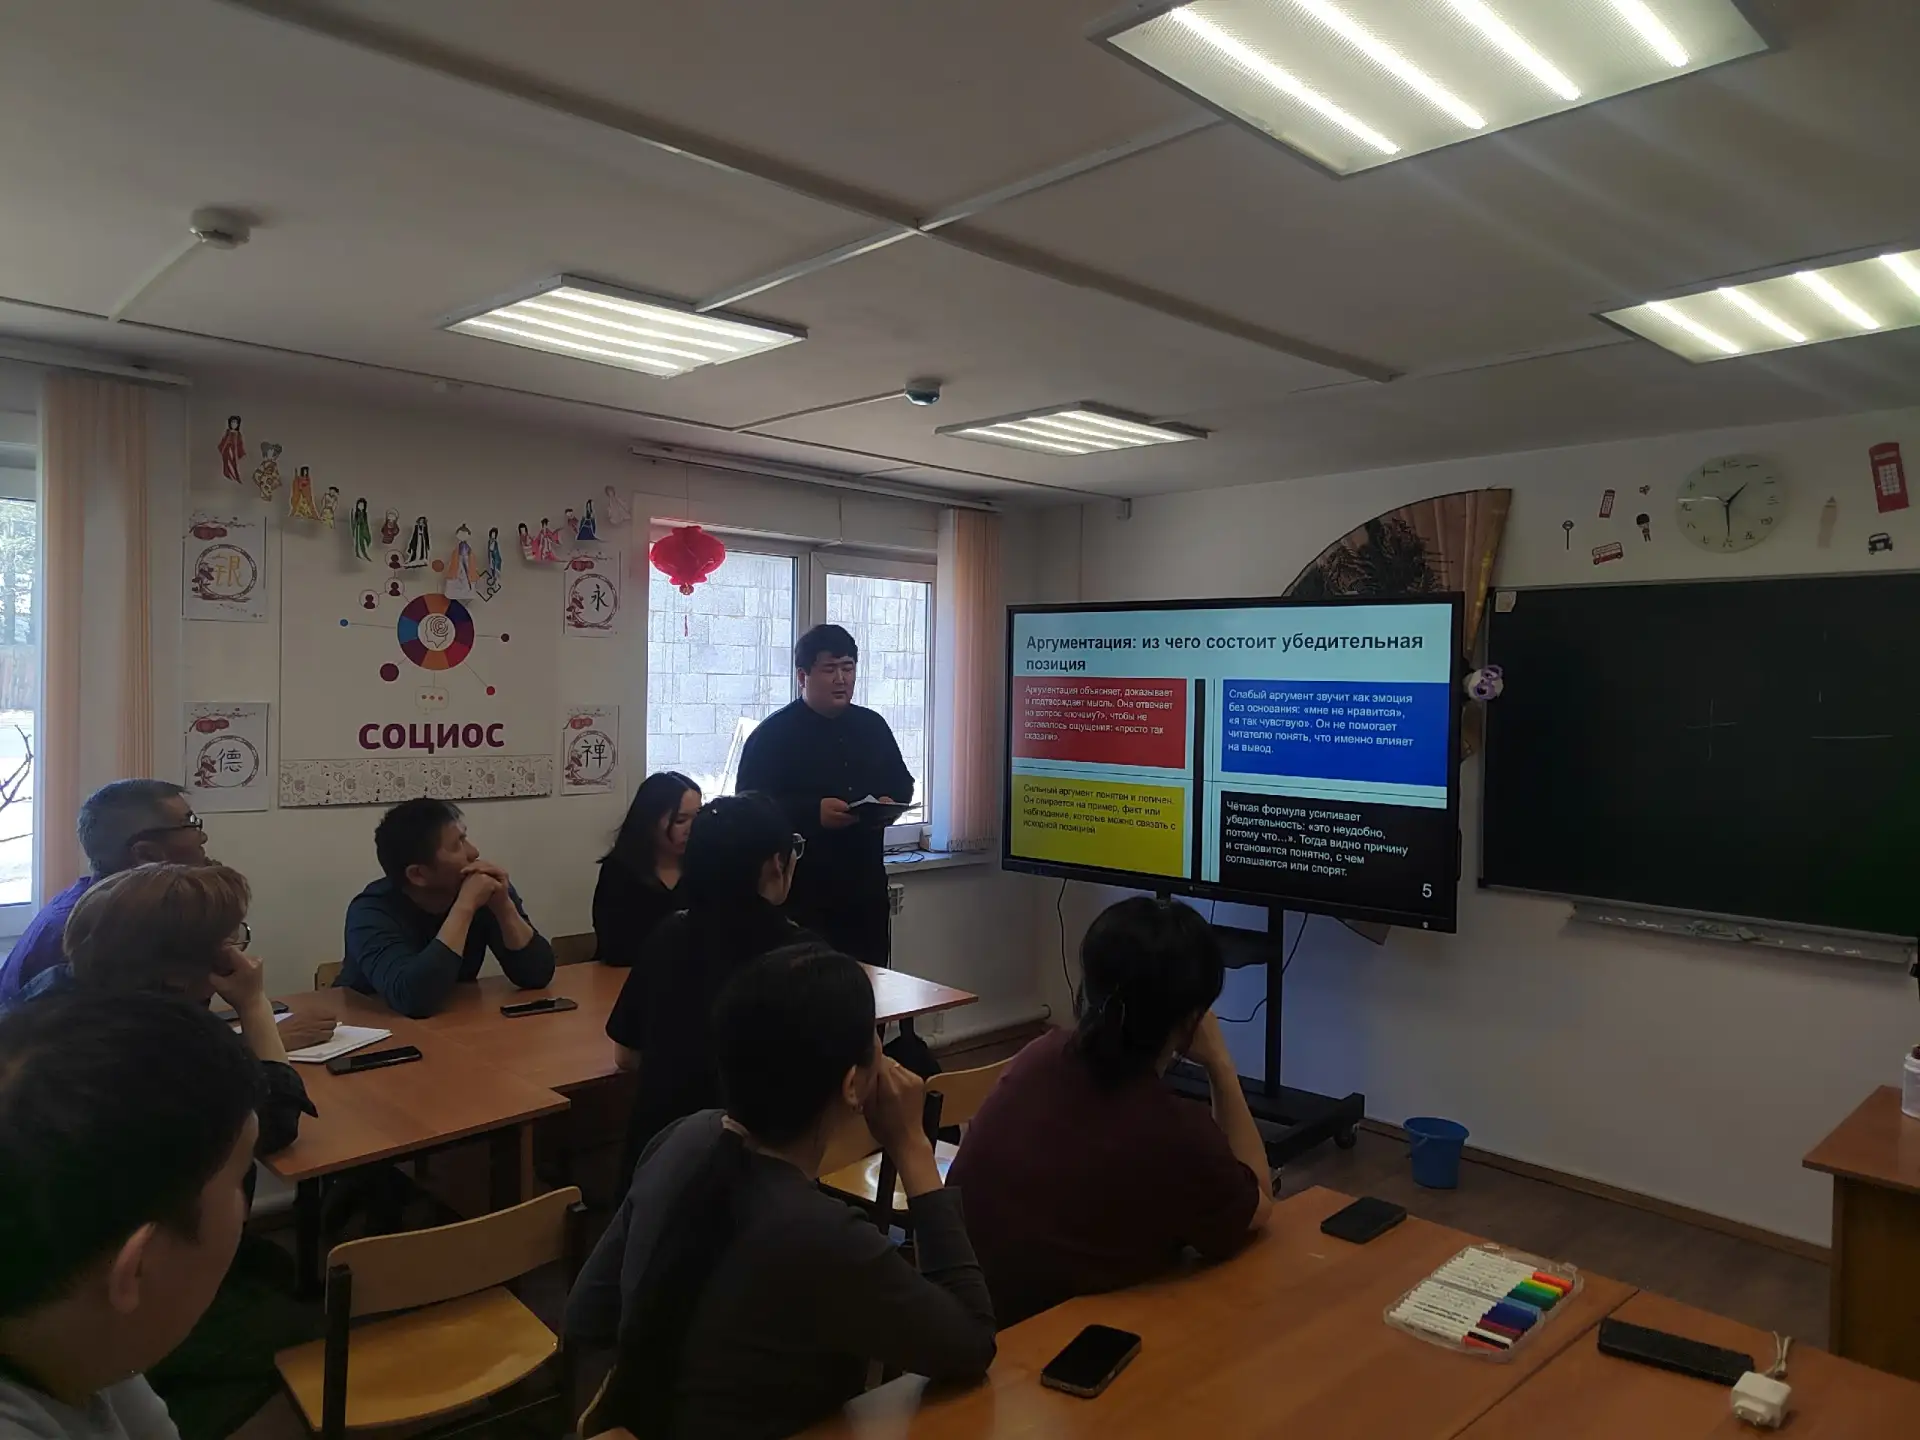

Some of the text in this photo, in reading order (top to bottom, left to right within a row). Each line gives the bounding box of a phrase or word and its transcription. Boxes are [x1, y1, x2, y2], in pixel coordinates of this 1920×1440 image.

[590, 583, 610, 612] 永
[1027, 633, 1423, 652] Аргументация: из чего состоит убедительная
[1027, 660, 1086, 671] позиция
[1025, 686, 1078, 695] Аргументация
[1229, 689, 1266, 699] Слабый
[1269, 693, 1313, 703] аргумент
[1316, 693, 1349, 703] звучит
[1373, 695, 1412, 704] эмоция
[1229, 703, 1244, 712] без
[1247, 705, 1300, 714] основания:
[1304, 707, 1328, 715] «мне
[1347, 708, 1405, 718] нравится»,
[1069, 724, 1113, 732] ощущения:
[1115, 726, 1148, 734] «просто
[1260, 719, 1313, 729] чувствую».
[1316, 719, 1330, 728] Он
[1349, 722, 1397, 731] помогает
[1229, 731, 1272, 739] читателю
[1275, 733, 1311, 742] понять,
[1334, 735, 1373, 744] именно
[1376, 737, 1413, 746] влияет
[1242, 745, 1274, 753] вывод.
[217, 748, 243, 772] 德
[1024, 784, 1057, 794] Сильный
[1059, 789, 1093, 797] аргумент
[1096, 792, 1128, 800] понятен
[1088, 803, 1119, 813] пример,
[1122, 805, 1141, 814] факт
[1227, 801, 1361, 822] Чёткая формула усиливает
[1074, 814, 1105, 823] которые
[1136, 820, 1168, 830] связать
[1226, 815, 1386, 839] убедительность: «это неудобно,
[1226, 828, 1259, 841] потому
[1299, 835, 1327, 848] Тогда
[1330, 840, 1361, 850] видно
[1364, 843, 1408, 856] причину
[1234, 842, 1287, 855] становится
[1290, 849, 1332, 861] понятно,
[1344, 855, 1364, 864] чем
[1226, 855, 1347, 876] соглашаются или спорят.
[1422, 884, 1432, 898] 5
